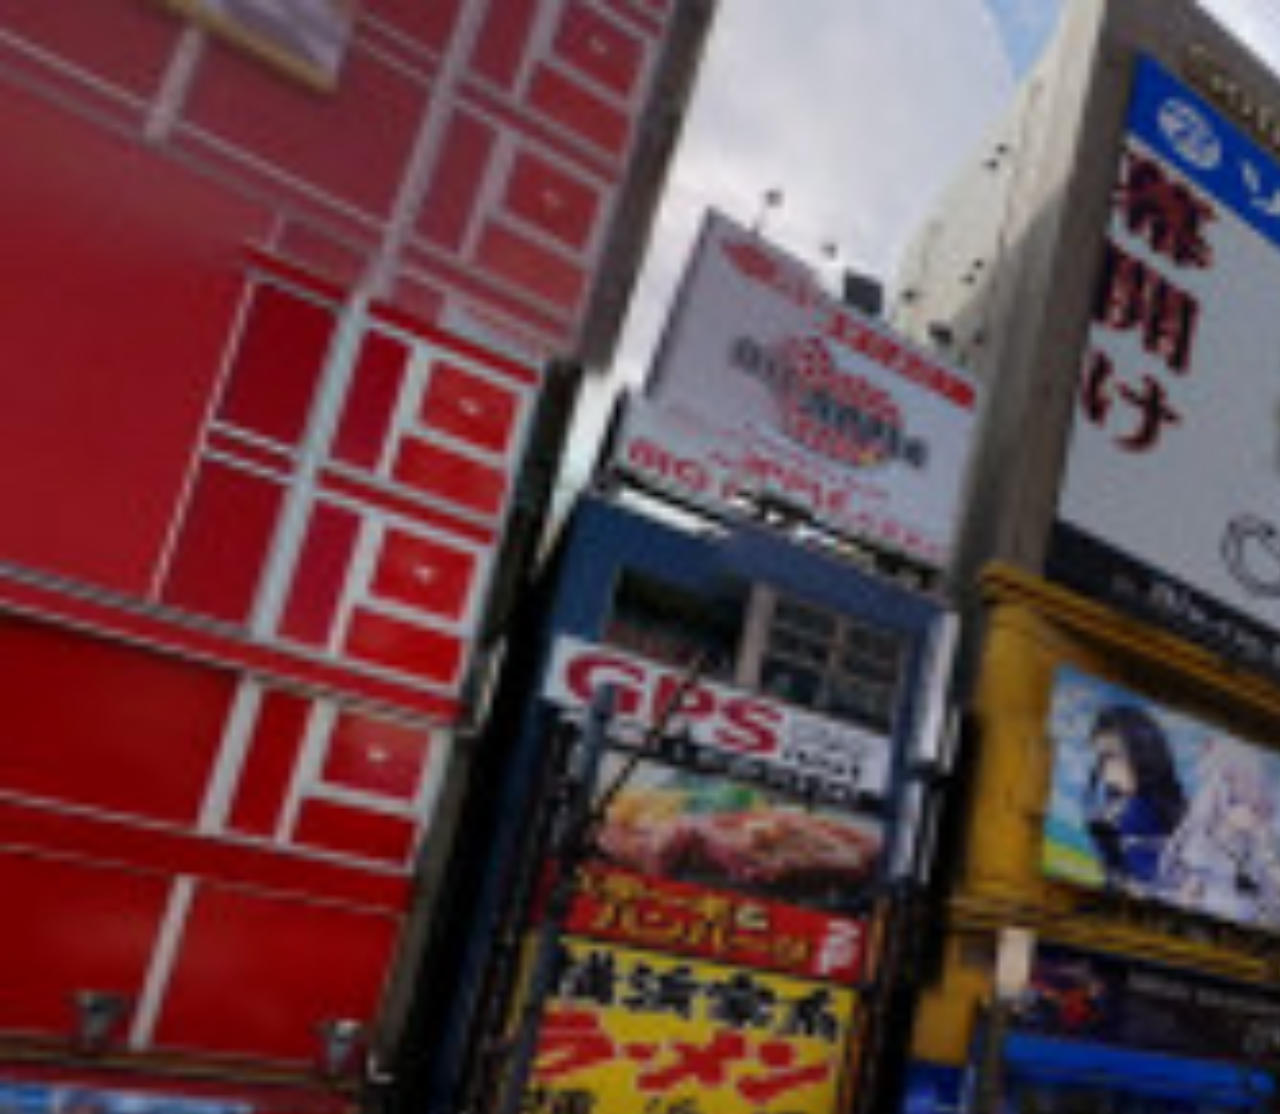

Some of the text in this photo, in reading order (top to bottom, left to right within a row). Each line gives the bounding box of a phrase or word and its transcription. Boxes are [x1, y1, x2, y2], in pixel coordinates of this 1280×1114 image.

[564, 649, 784, 757] GPS
[535, 1006, 832, 1106] ラーメン
